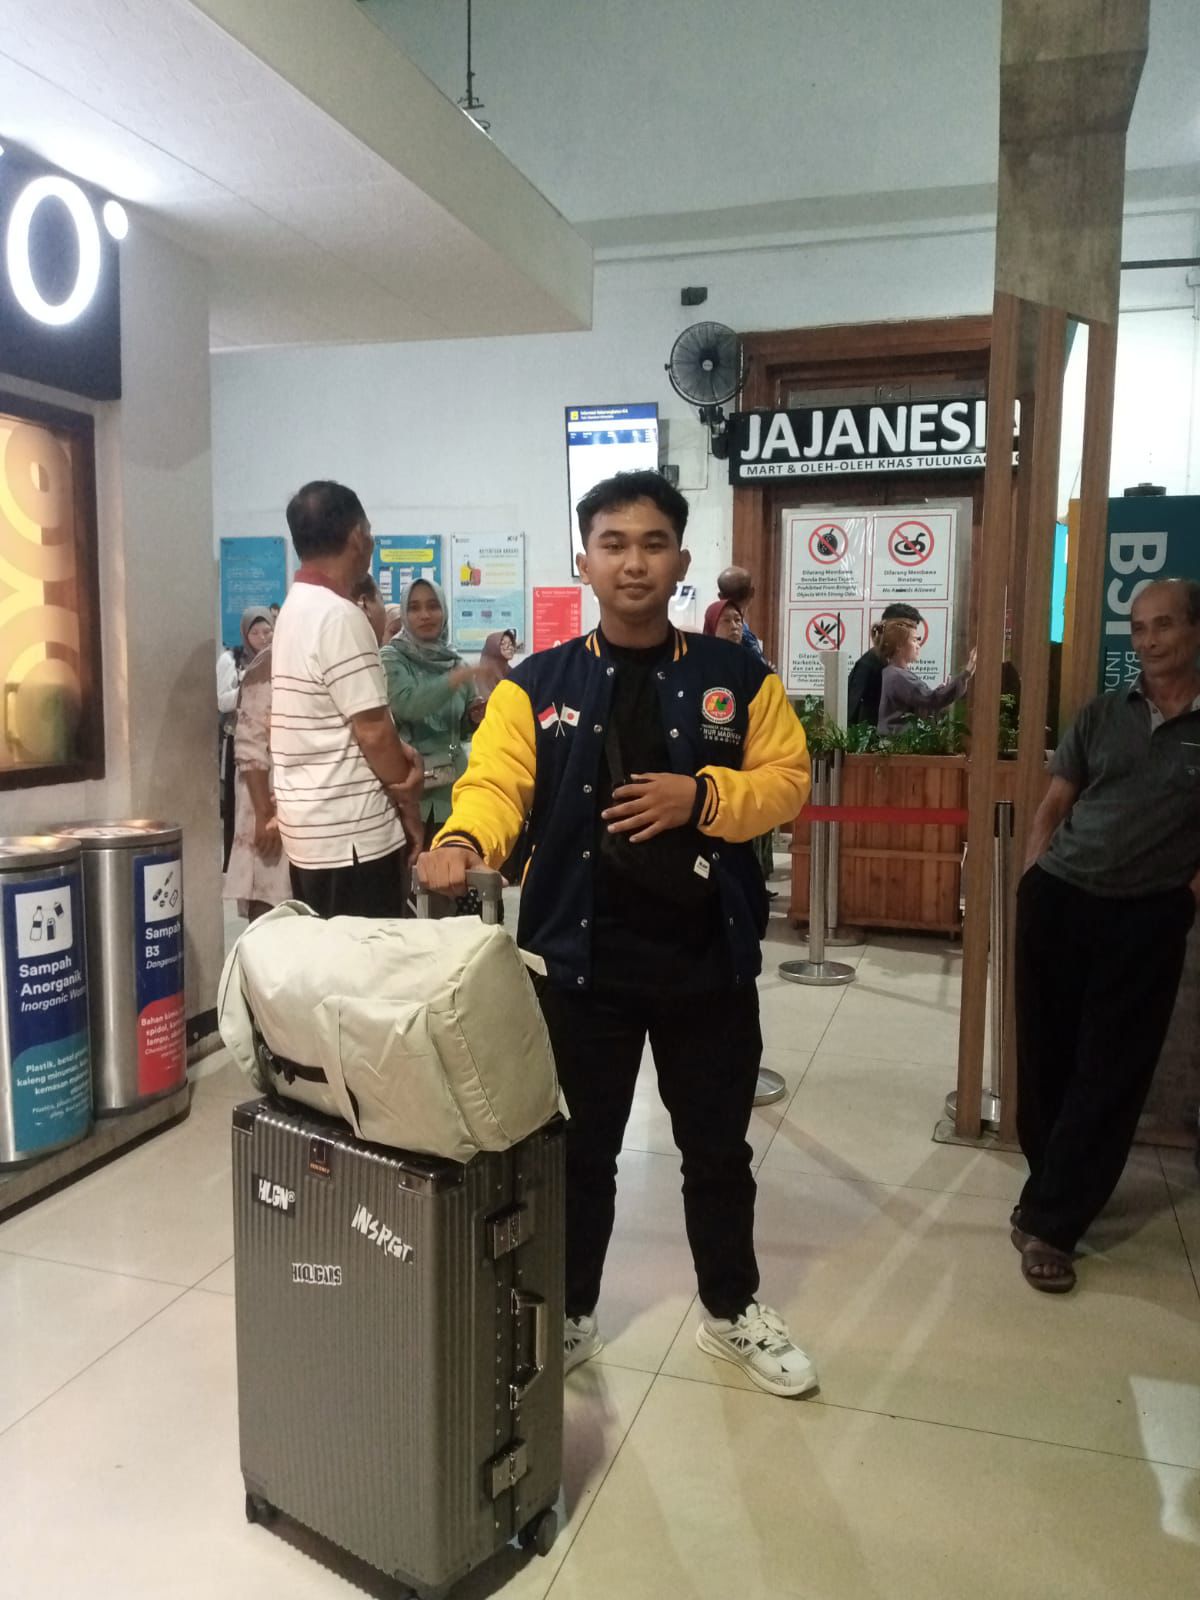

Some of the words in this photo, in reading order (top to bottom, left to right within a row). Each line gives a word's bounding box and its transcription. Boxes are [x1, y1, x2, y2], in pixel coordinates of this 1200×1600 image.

[740, 399, 1020, 460] JAJANESI
[746, 465, 783, 476] MART
[787, 463, 797, 474] &
[800, 460, 873, 473] OLEH-OLEH
[878, 458, 914, 469] KHAS
[917, 452, 1019, 467] TULUNGA
[145, 920, 181, 940] Sampah
[145, 945, 160, 958] B3
[19, 954, 72, 978] Sampah
[20, 969, 82, 997] Anorganik
[21, 993, 69, 1012] Inorganic
